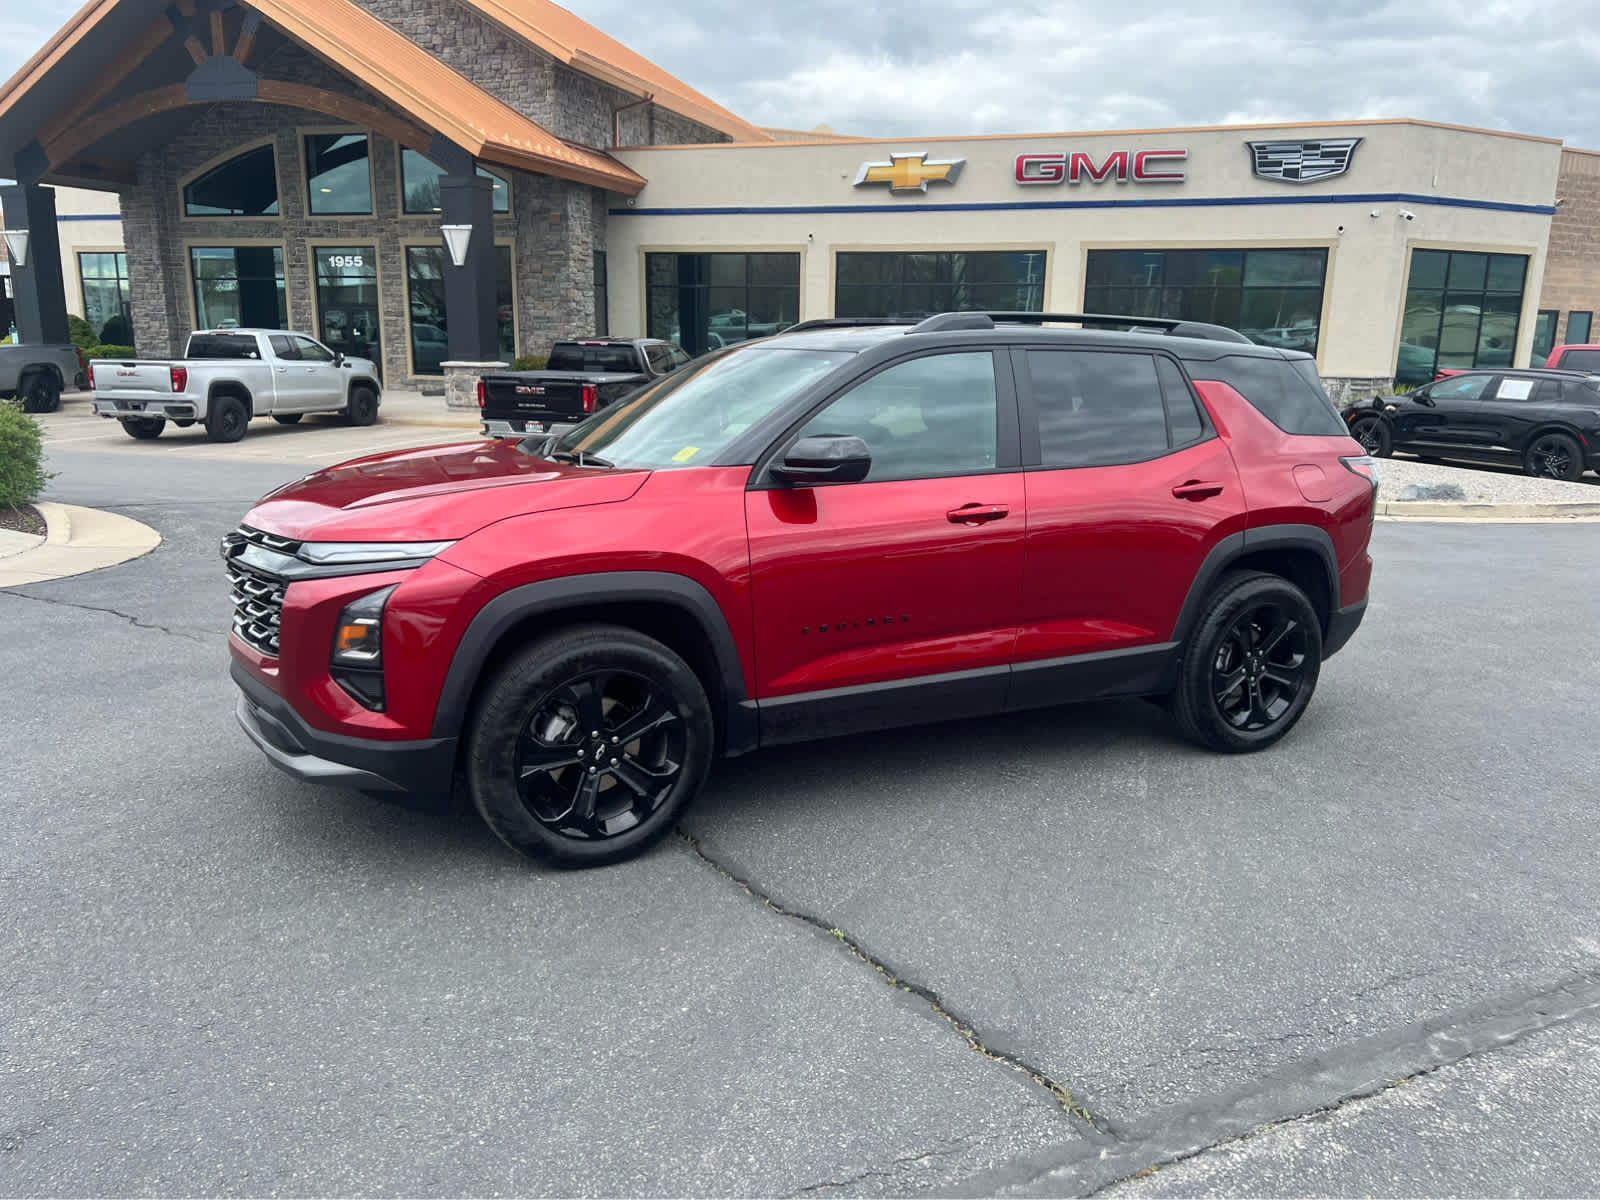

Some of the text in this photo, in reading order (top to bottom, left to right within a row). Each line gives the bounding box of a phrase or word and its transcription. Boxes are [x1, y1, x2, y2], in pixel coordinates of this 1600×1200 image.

[1015, 149, 1188, 185] GMC
[328, 255, 363, 267] 1955
[515, 386, 545, 394] GMC
